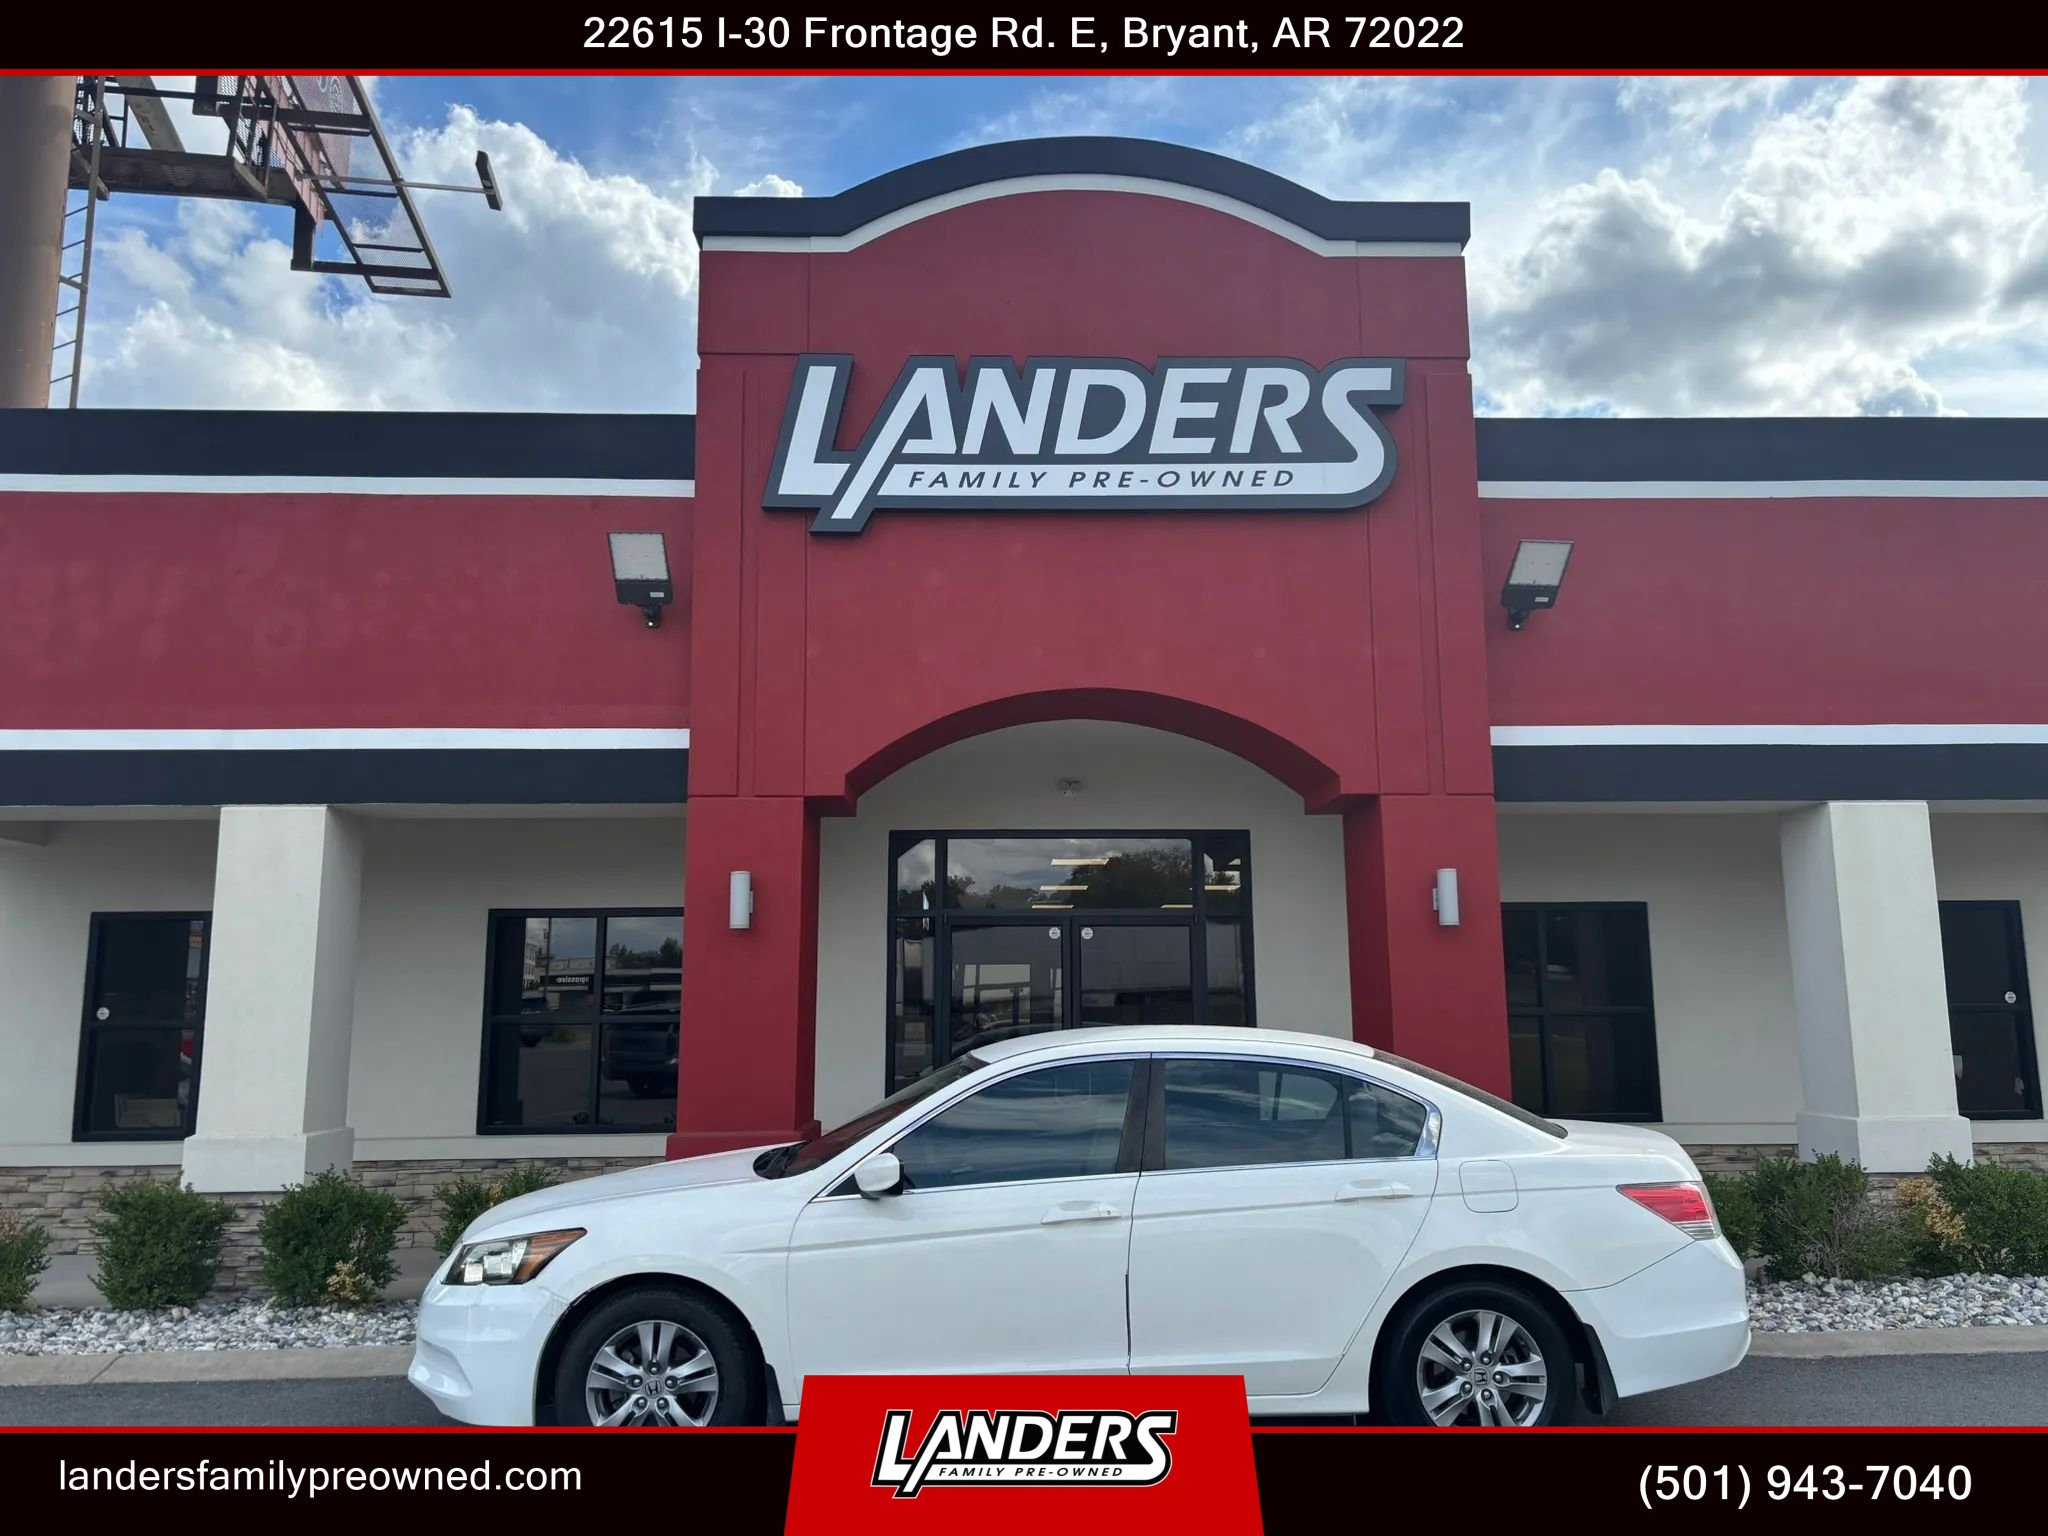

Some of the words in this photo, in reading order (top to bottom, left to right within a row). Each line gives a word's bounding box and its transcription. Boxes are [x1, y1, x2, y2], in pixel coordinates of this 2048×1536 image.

[778, 366, 1392, 518] LANDERS
[908, 471, 1048, 489] FAMILY
[1069, 470, 1296, 488] PRE-OWNED
